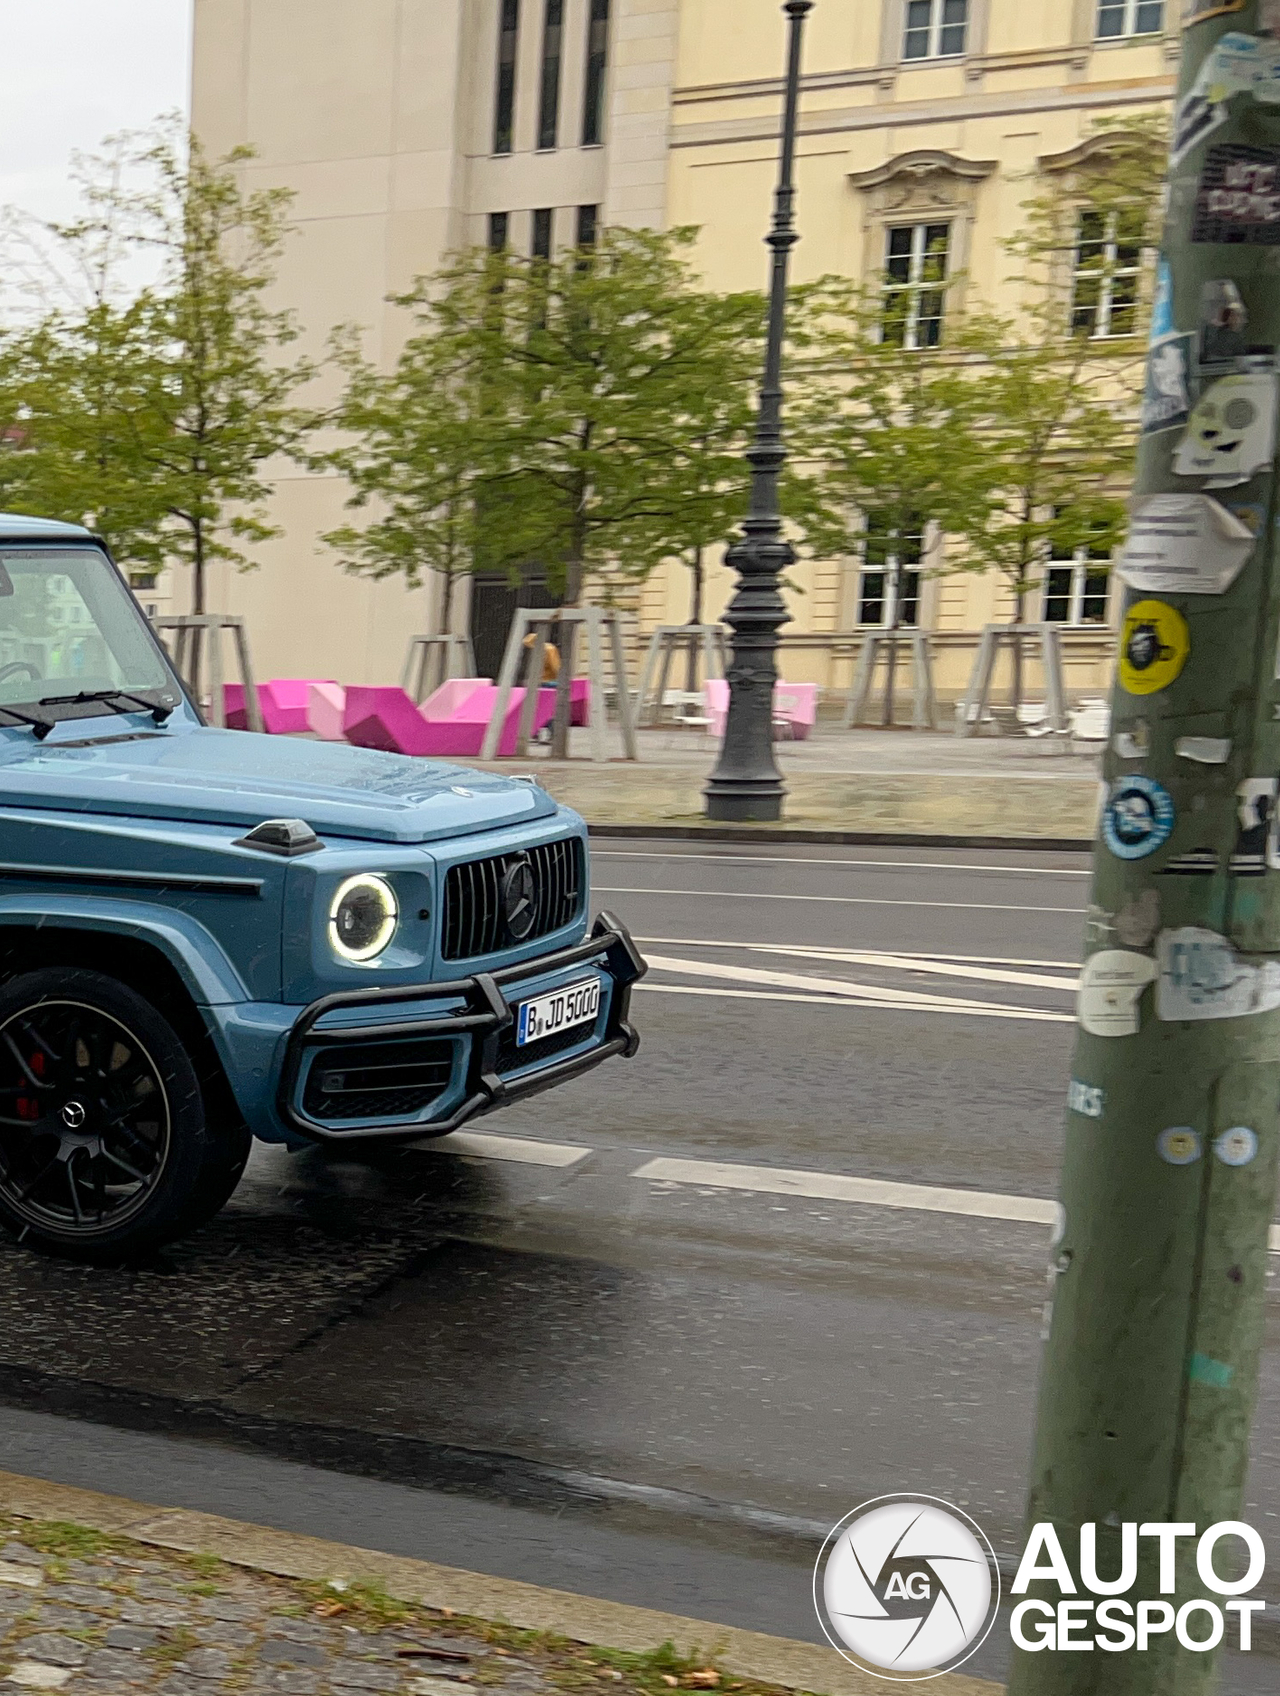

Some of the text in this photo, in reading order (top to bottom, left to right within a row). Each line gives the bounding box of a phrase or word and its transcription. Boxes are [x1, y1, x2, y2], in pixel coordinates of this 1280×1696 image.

[527, 984, 598, 1037] B JD 5000
